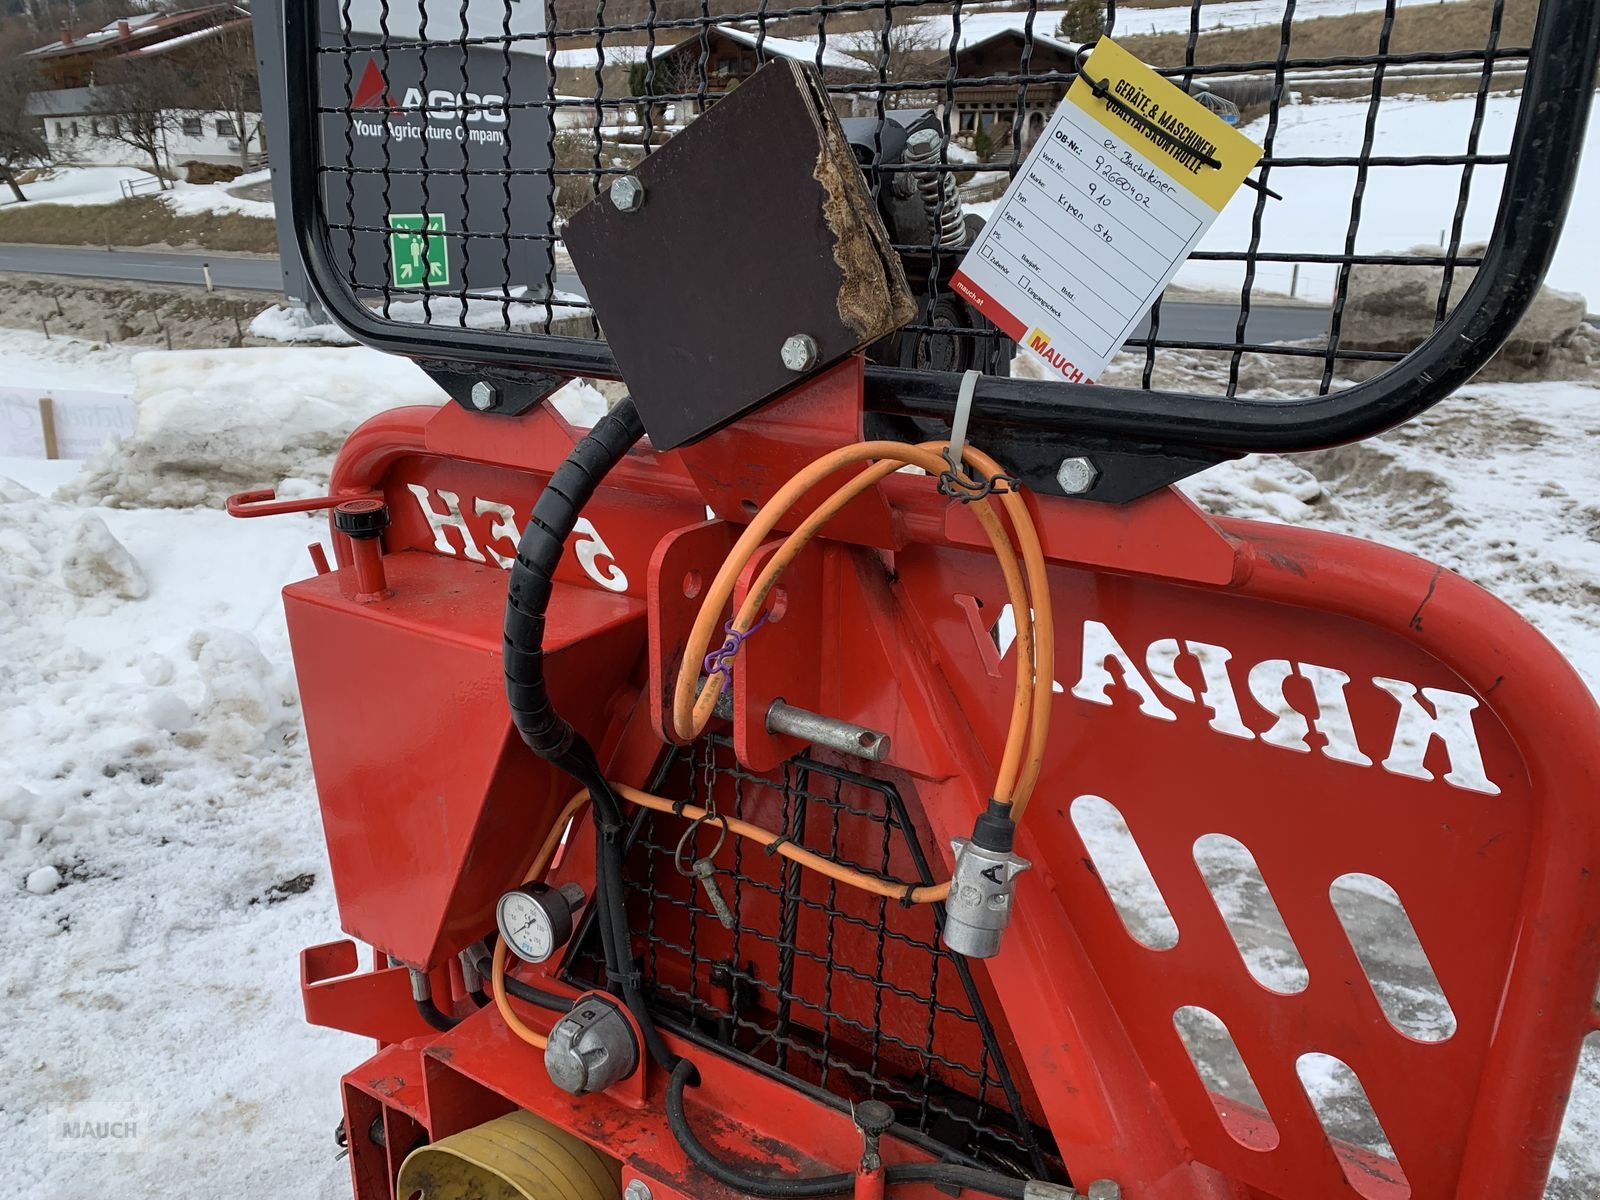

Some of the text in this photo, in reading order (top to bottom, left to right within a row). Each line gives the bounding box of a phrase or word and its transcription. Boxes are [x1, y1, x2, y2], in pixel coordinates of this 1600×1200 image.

[402, 88, 506, 122] AGCO
[1115, 79, 1217, 158] GERÄTE & MASCHINEN
[353, 120, 383, 136] Your
[455, 125, 505, 146] Cmpany
[1055, 130, 1083, 156] OB-Nr.:
[956, 281, 984, 307] mauch.at
[989, 255, 1062, 318] Zubehör Eingangscheck
[1030, 335, 1084, 384] MAUCH
